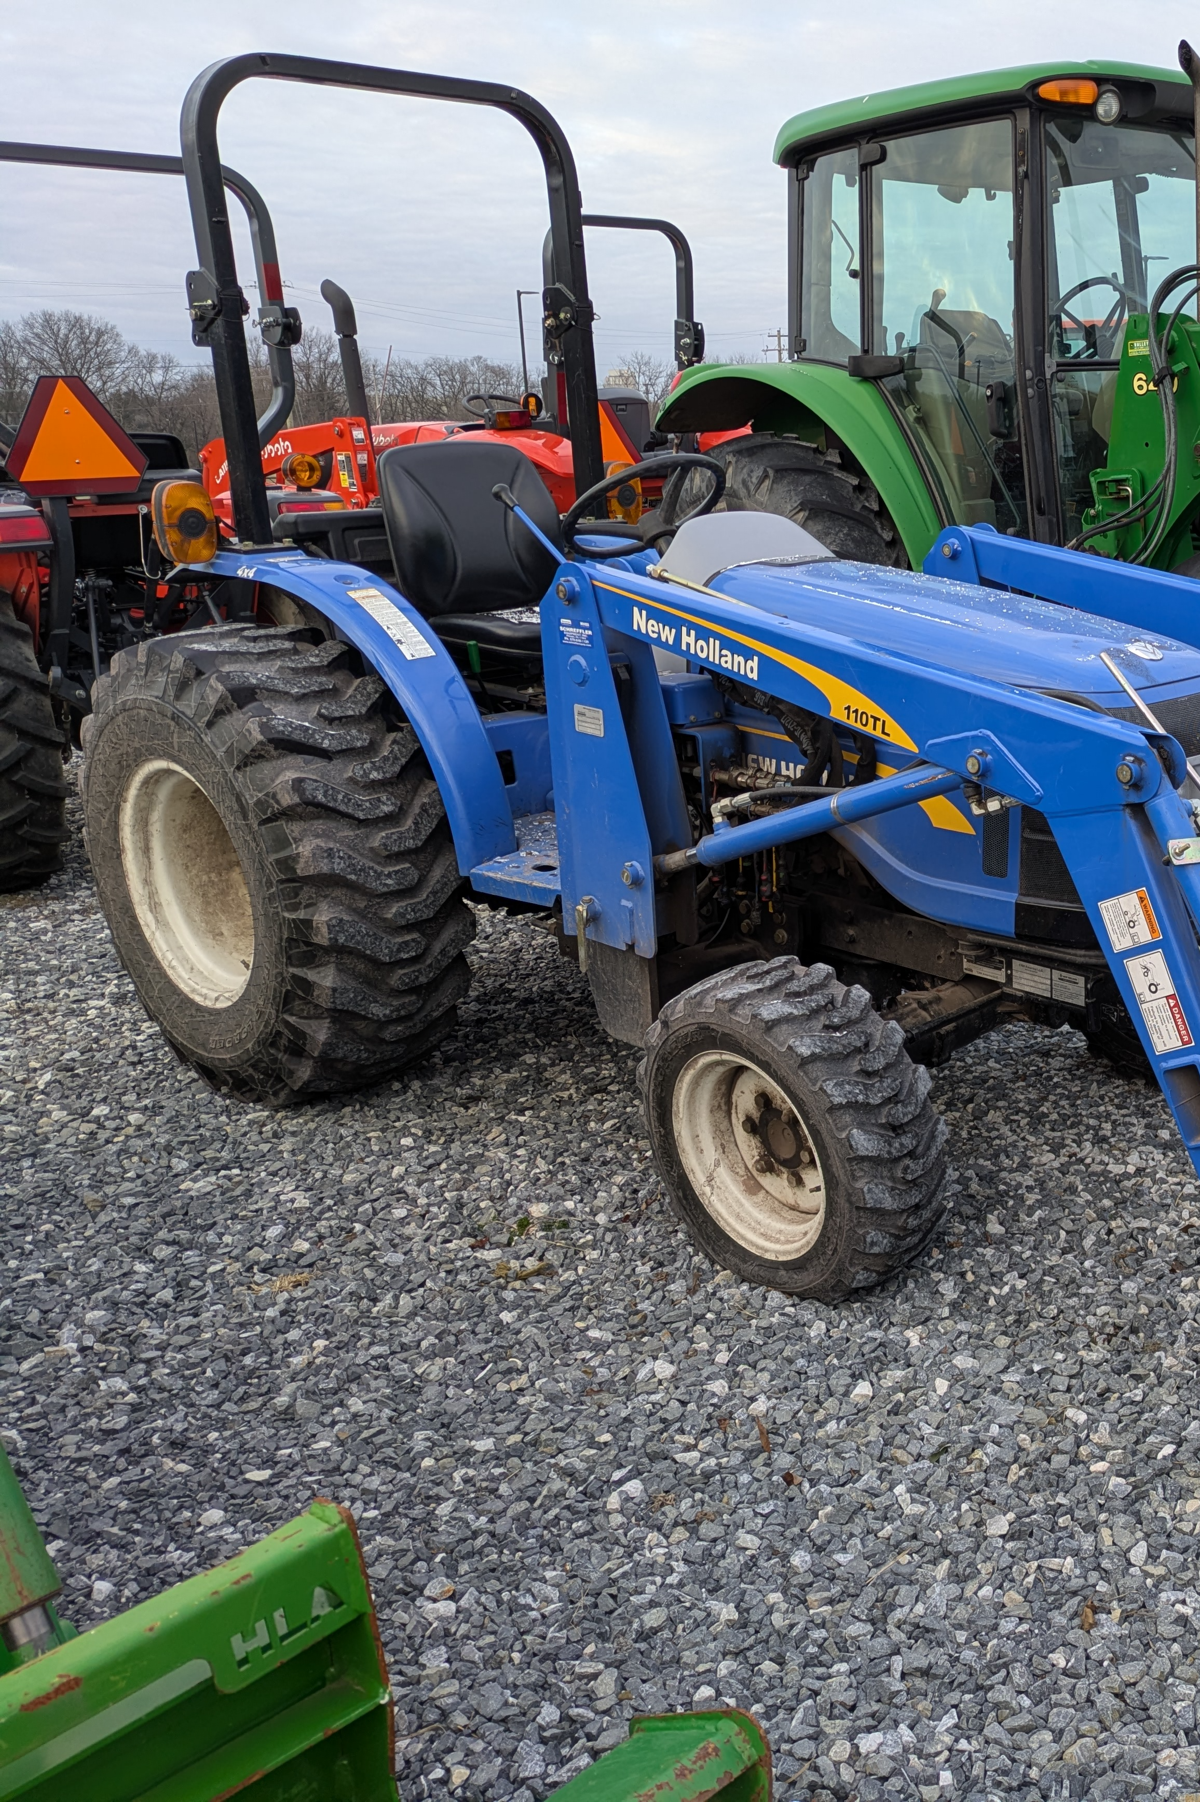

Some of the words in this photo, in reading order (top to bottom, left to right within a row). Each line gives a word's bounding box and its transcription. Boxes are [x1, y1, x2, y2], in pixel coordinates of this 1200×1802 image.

[632, 605, 676, 645] New
[680, 625, 759, 681] Holland
[843, 703, 891, 738] 110TL
[1142, 902, 1158, 935] WARNING
[1171, 1006, 1190, 1043] DANGER
[230, 1585, 347, 1671] HLA
